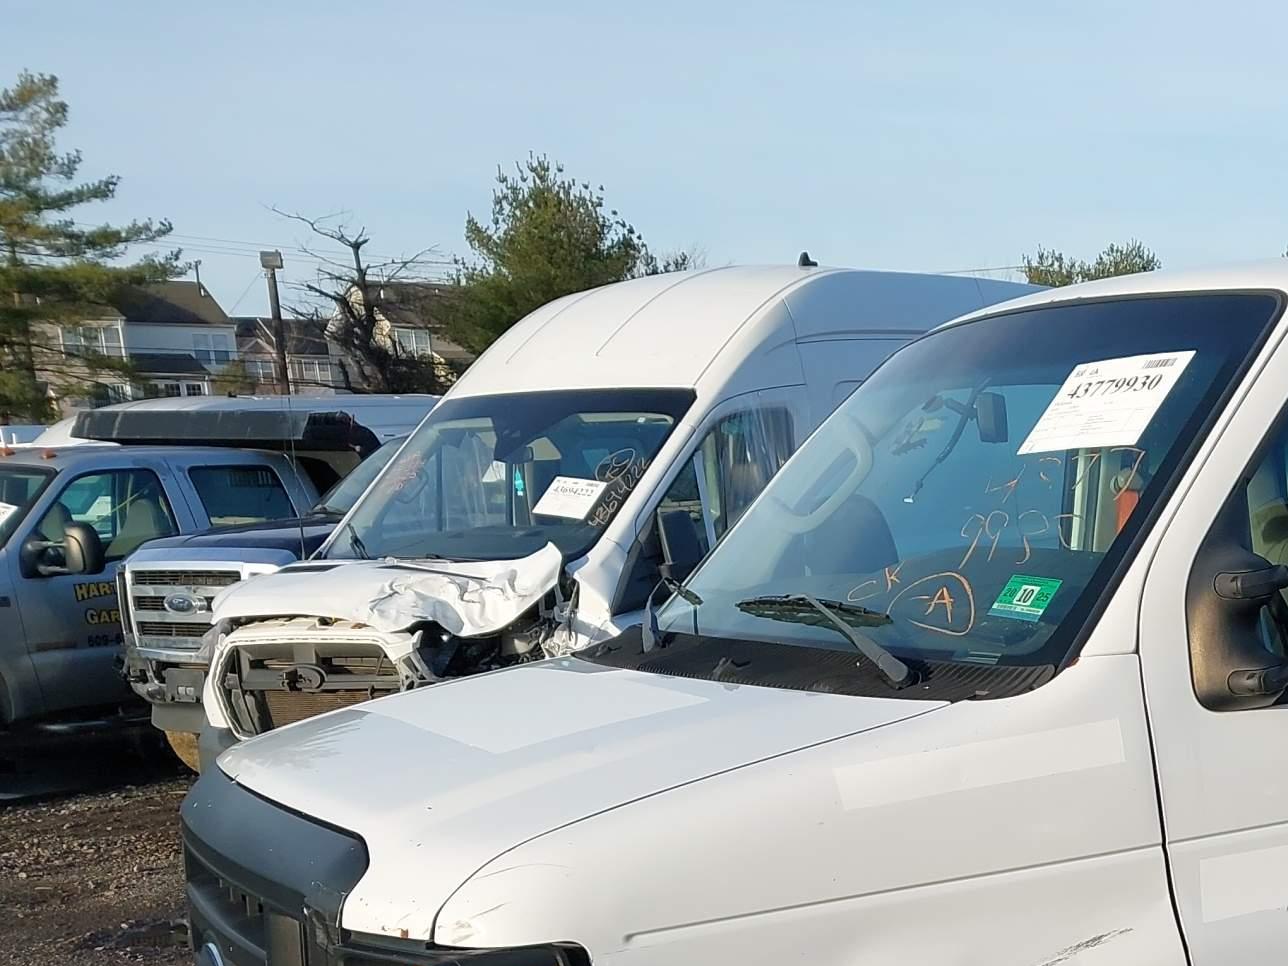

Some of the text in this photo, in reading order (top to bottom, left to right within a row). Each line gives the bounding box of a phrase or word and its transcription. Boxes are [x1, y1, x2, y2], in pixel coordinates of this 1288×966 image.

[1067, 373, 1163, 399] 43779930
[1015, 588, 1035, 604] 10
[1036, 591, 1052, 602] 25
